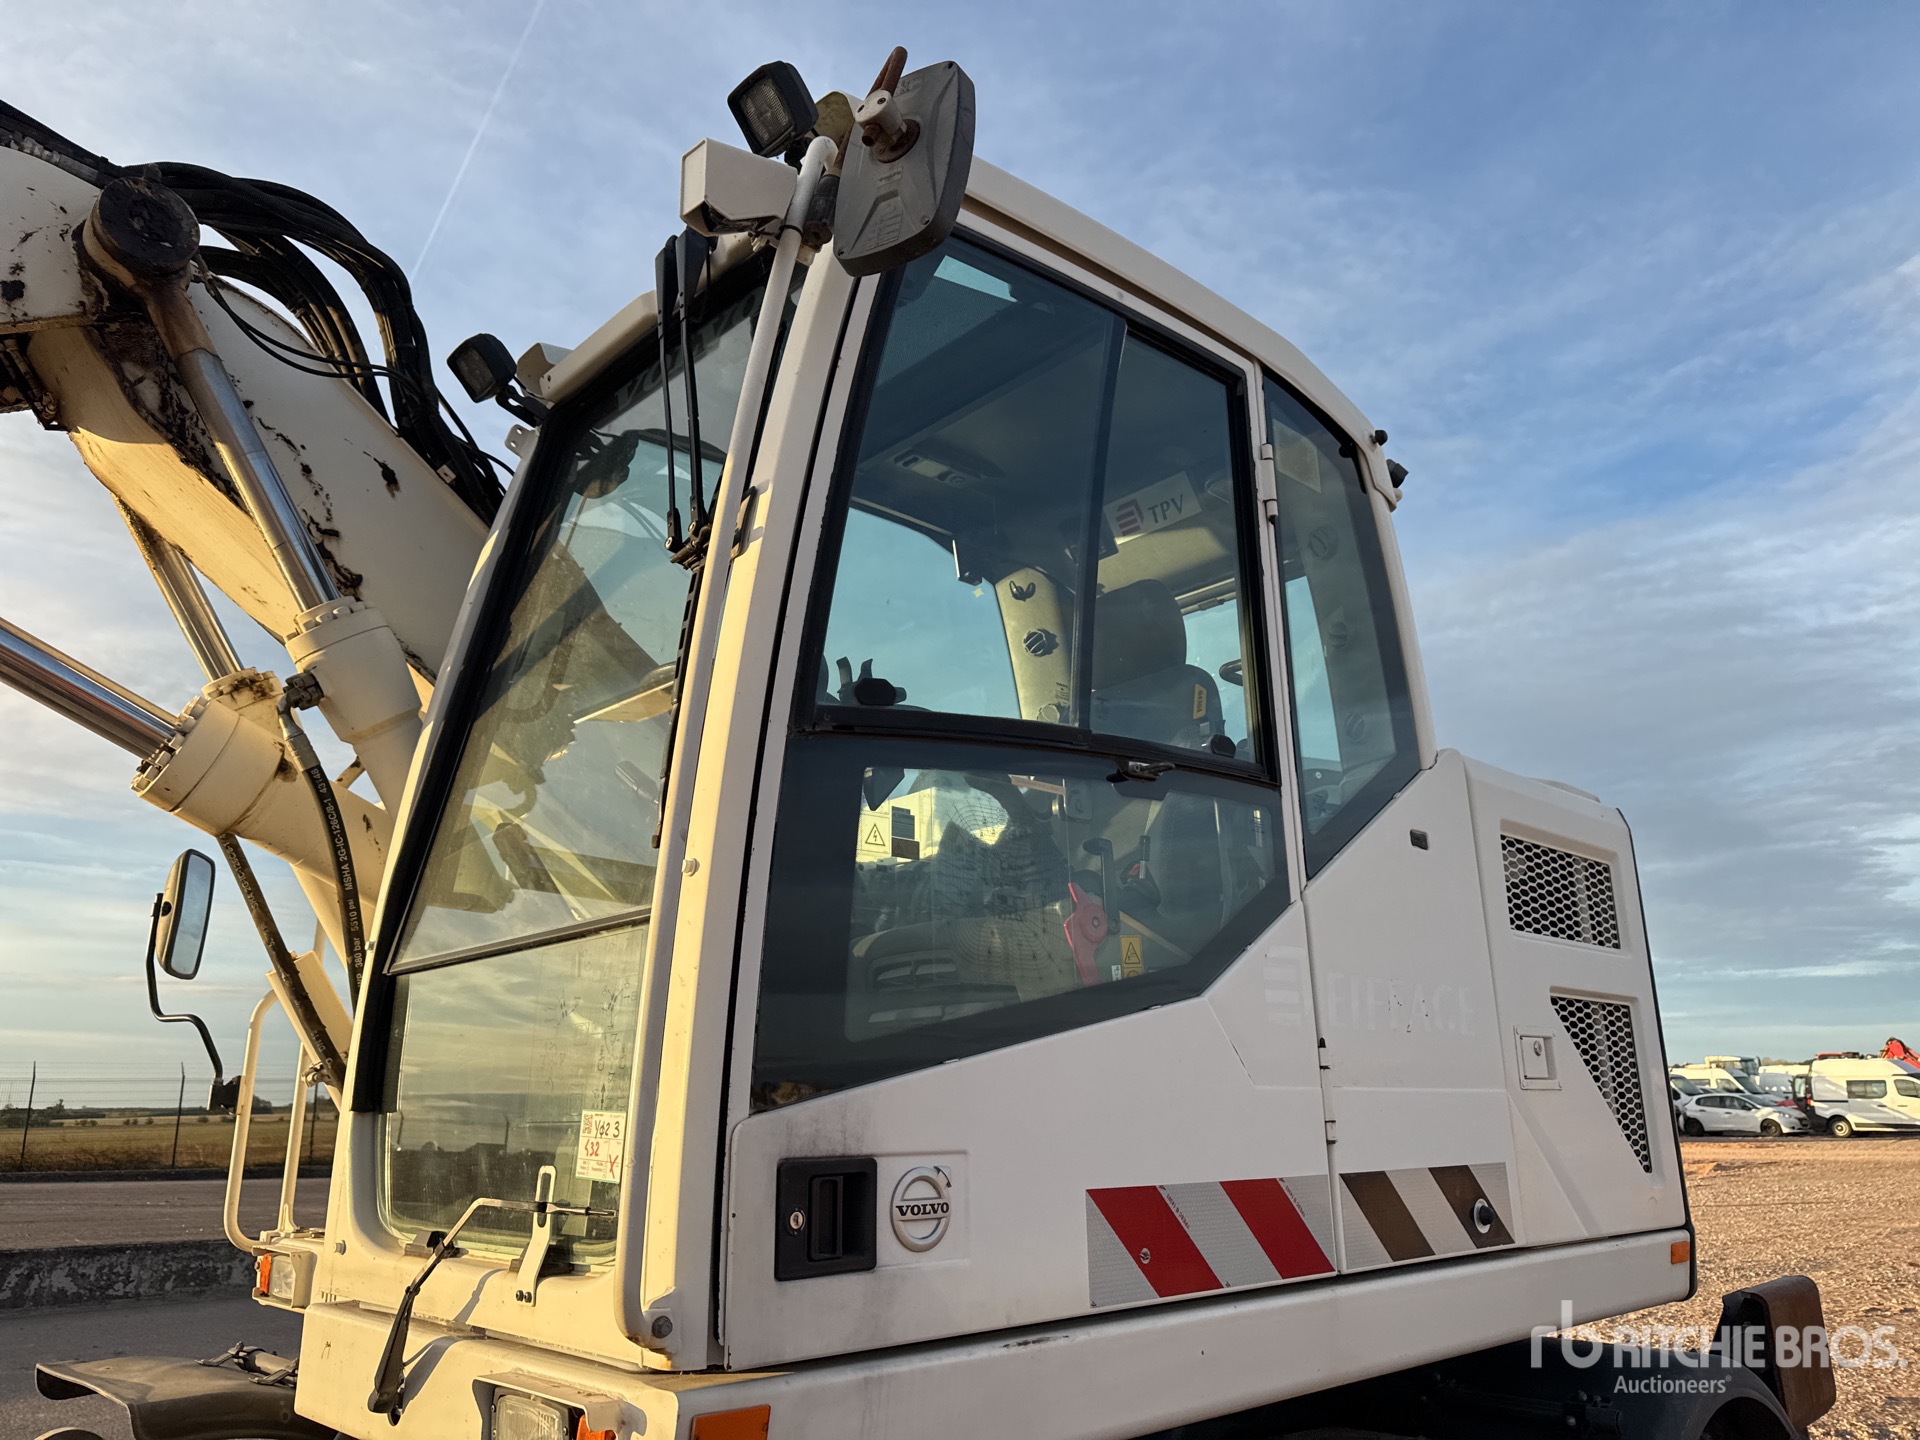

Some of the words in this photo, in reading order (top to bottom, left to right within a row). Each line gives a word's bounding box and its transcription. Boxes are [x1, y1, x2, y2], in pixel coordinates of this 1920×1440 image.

[614, 285, 766, 412] VOVO
[1147, 494, 1184, 524] TPV
[341, 863, 353, 890] MSHA
[348, 899, 356, 909] psi
[349, 911, 359, 932] 5510
[353, 937, 361, 952] bar
[354, 952, 363, 968] 380
[895, 1202, 950, 1217] VOLVO
